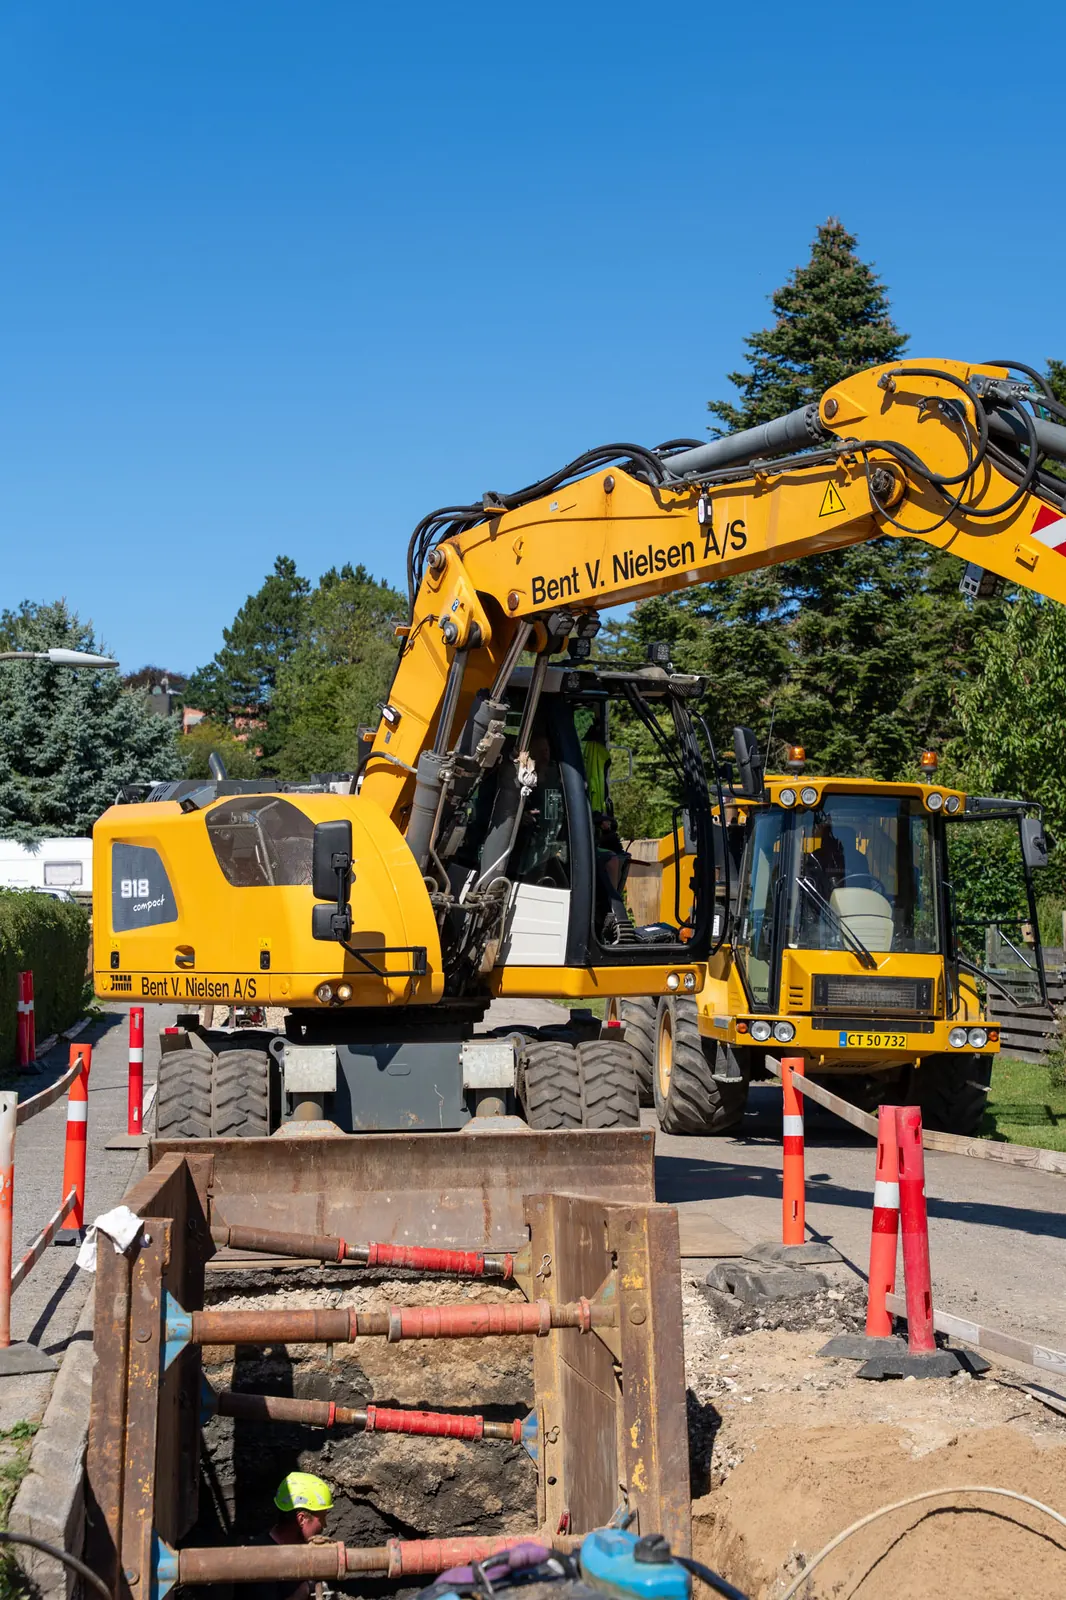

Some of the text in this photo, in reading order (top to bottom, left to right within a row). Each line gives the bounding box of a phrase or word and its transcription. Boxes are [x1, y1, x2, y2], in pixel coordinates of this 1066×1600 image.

[532, 519, 747, 604] Bent V. Nielsen A/S
[120, 879, 149, 898] 918
[133, 894, 165, 912] compact
[141, 977, 257, 1000] Bent V. Nielsen A/S
[848, 1034, 863, 1046] CT
[867, 1035, 881, 1046] 50
[884, 1036, 905, 1047] 732
